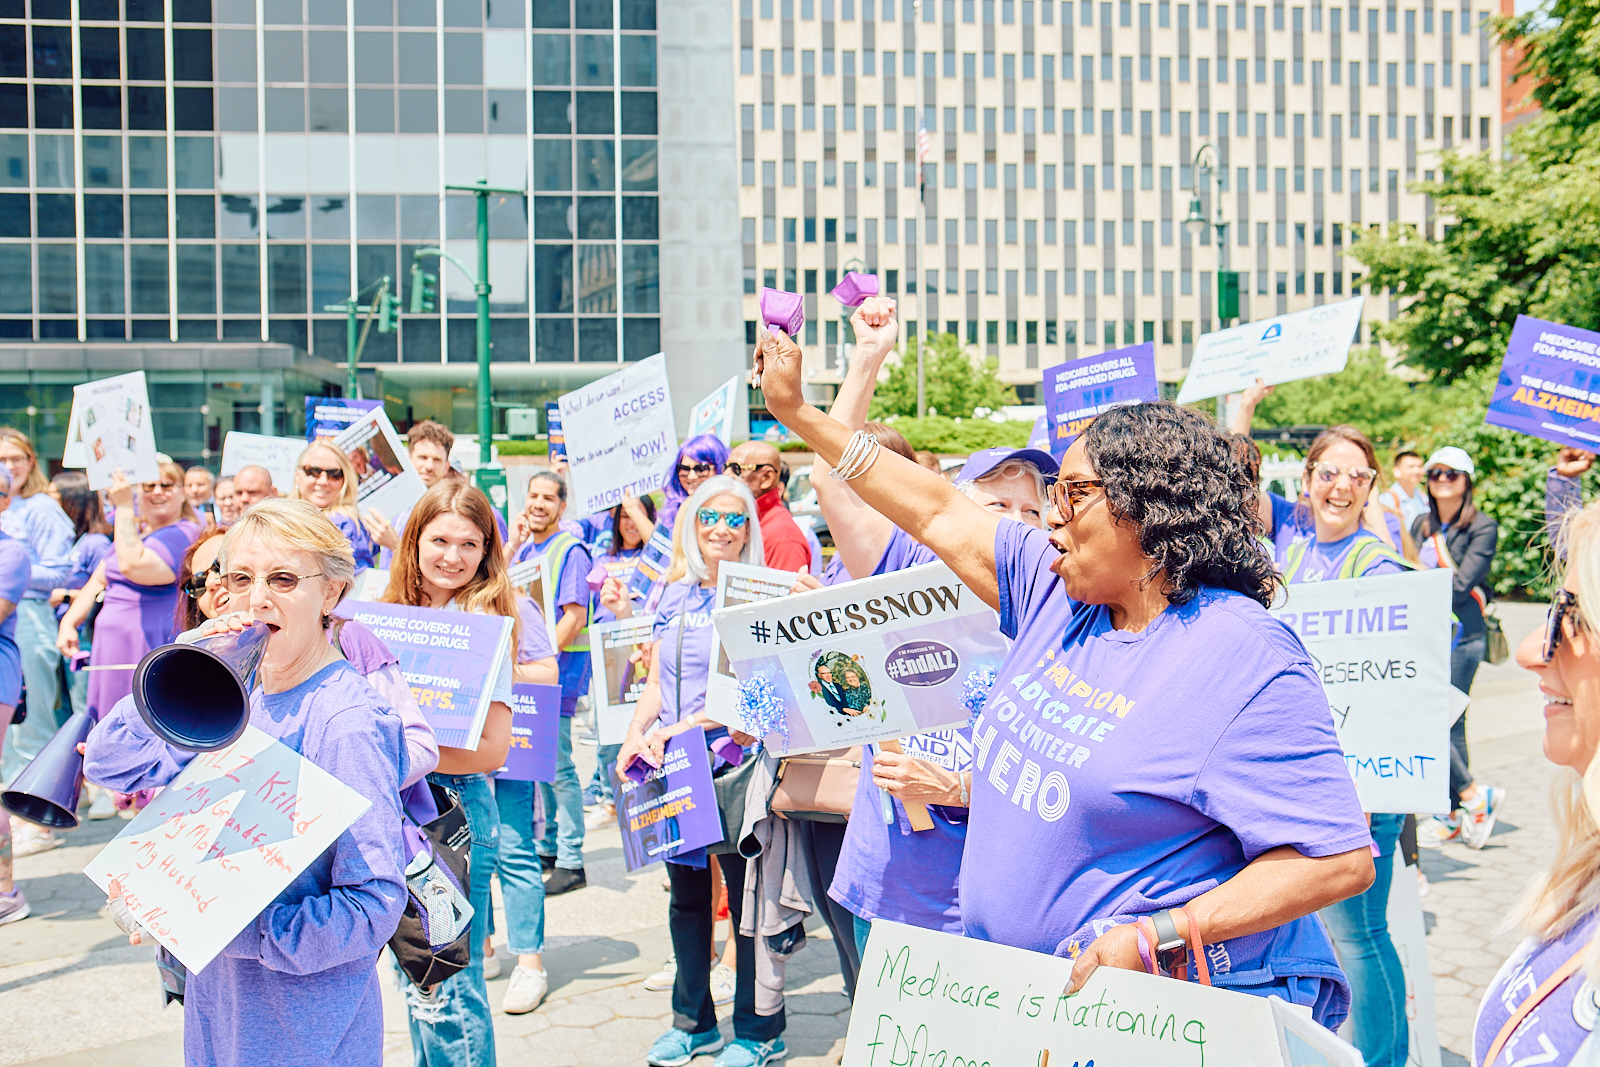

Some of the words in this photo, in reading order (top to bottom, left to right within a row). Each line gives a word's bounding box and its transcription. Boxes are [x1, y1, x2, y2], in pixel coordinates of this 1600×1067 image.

[1056, 365, 1090, 383] MEDICARE
[1089, 359, 1119, 375] COVERS
[1119, 356, 1135, 367] ALL
[1532, 342, 1600, 368] FDA-APPRO
[1054, 371, 1107, 394] FDA-APPROVED
[1108, 366, 1138, 381] DRUGS.
[1521, 375, 1543, 389] THE
[1542, 380, 1589, 401] GLARING
[613, 386, 666, 421] ACCESS
[1512, 387, 1600, 423] ALZHEIM
[631, 431, 668, 461] NOW!
[353, 612, 408, 629] MEDICARE
[407, 619, 451, 635] COVERS
[451, 625, 471, 637] ALL
[750, 583, 963, 645] #ACCESSNOW
[430, 635, 470, 650] DRUGS.
[887, 649, 957, 679] #EndALZ
[519, 694, 536, 705] ALL
[988, 690, 1091, 770] VOLUNTEER
[664, 757, 692, 776] DRUGS.
[673, 747, 688, 760] ALL
[971, 713, 1071, 823] HERO
[255, 770, 322, 835] Killed
[629, 796, 696, 832] ALZHEIMER'S.
[185, 823, 242, 873] Mother
[877, 945, 1000, 1010] Medicare
[1016, 983, 1045, 1018] is
[1053, 988, 1207, 1067] Rationing
